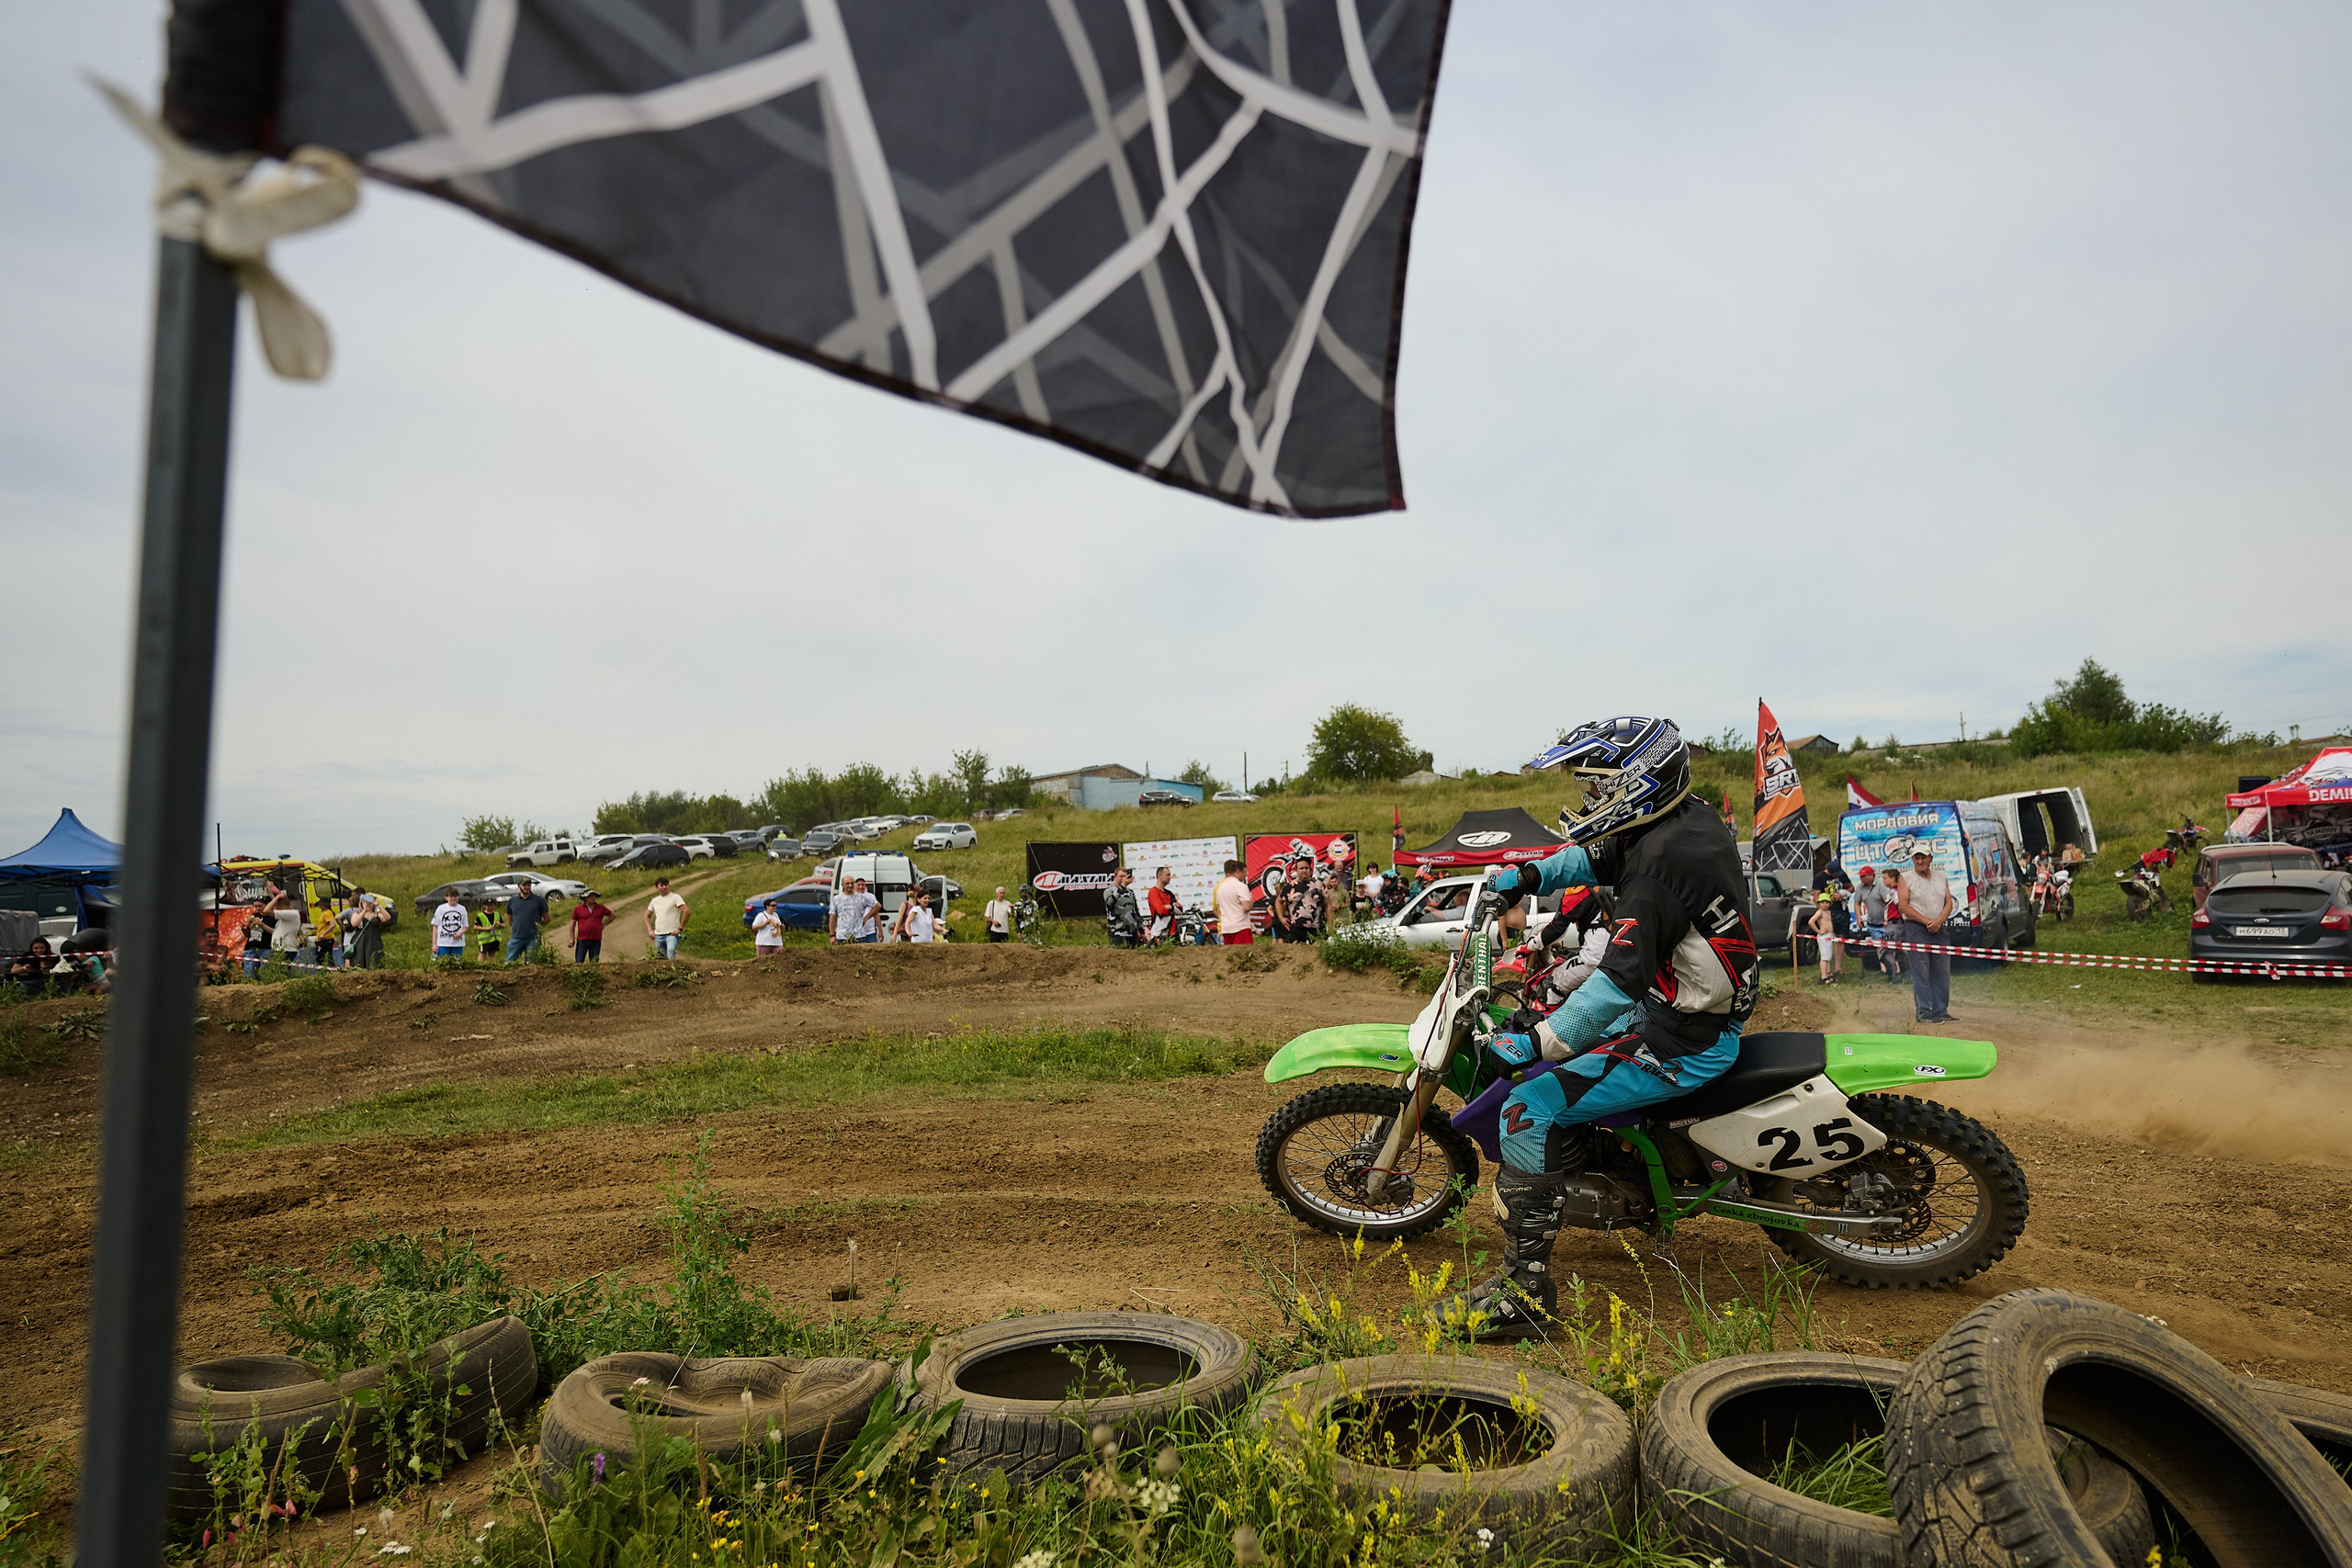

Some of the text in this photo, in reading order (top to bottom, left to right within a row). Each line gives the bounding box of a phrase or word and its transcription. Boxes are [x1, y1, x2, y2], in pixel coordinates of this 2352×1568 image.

[1854, 813, 1940, 832] МОРДОВИЯ
[1476, 935, 1487, 987] RENTHAL
[1669, 1117, 1700, 1129] MOTUL
[1757, 1117, 1865, 1171] 25
[1747, 1213, 1800, 1228] zbrojovka
